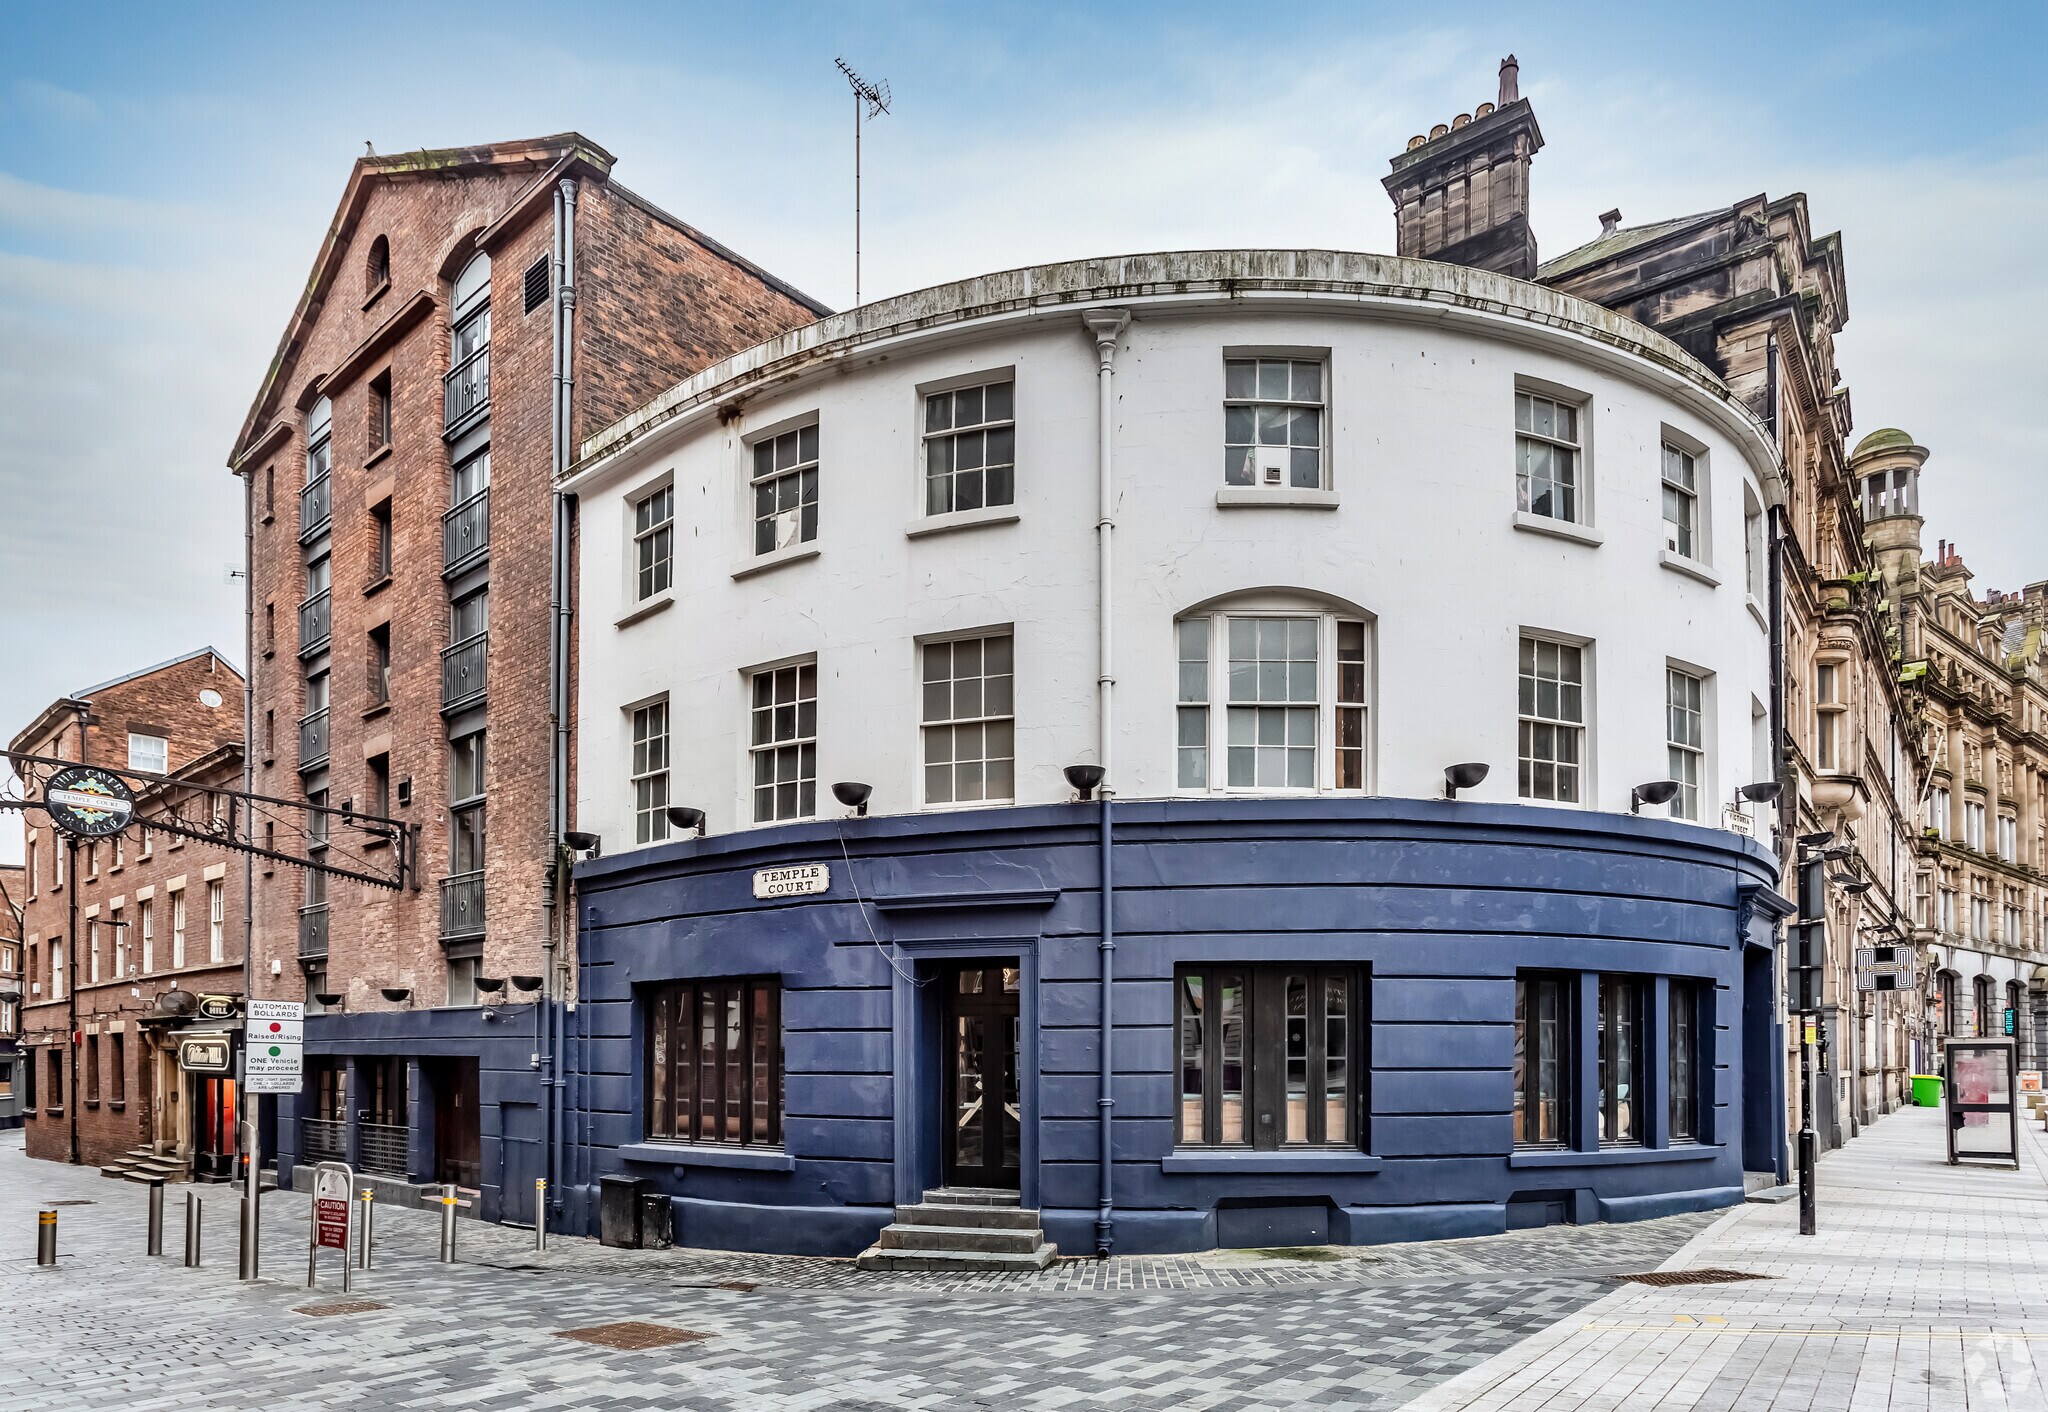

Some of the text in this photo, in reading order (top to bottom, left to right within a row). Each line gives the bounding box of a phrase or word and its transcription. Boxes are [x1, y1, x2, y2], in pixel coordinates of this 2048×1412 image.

[52, 770, 78, 788] THE
[63, 794, 119, 808] TEMPLE COURT
[1732, 824, 1748, 834] STREET
[762, 867, 819, 883] TEMPLE
[768, 880, 813, 894] COURT
[252, 1003, 300, 1011] AUTOMATIC
[254, 1010, 298, 1018] BOLLARDS
[248, 1033, 302, 1041] Raised/Rising
[320, 1200, 345, 1210] CAUTION
